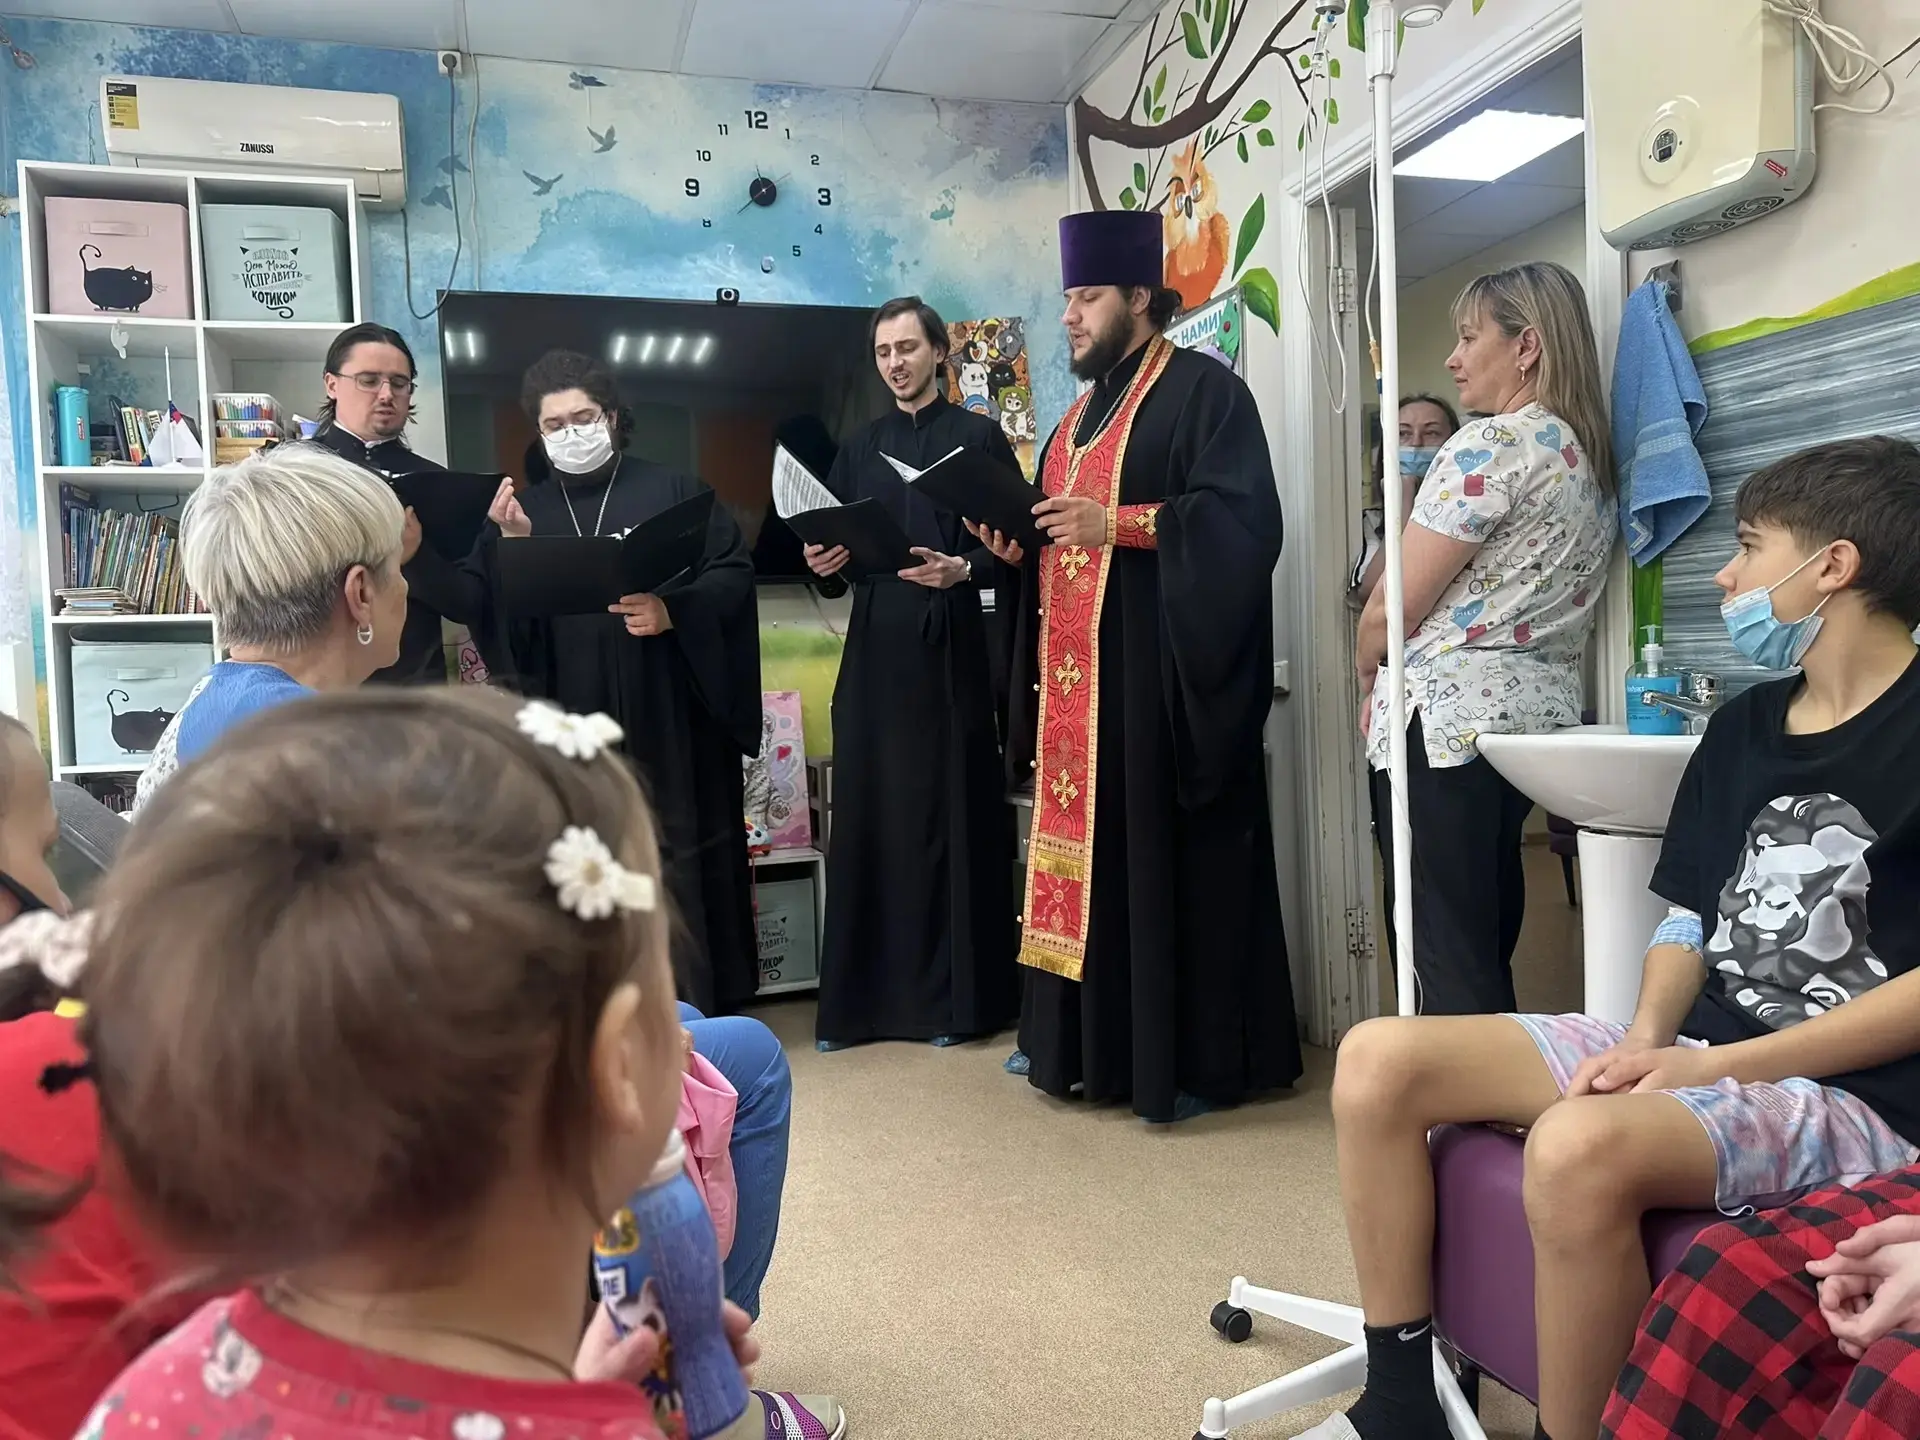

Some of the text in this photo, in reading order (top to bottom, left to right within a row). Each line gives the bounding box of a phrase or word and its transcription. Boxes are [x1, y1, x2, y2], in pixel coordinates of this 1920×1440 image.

[744, 110, 768, 129] 12
[718, 124, 728, 135] 11
[785, 128, 790, 139] 1
[240, 142, 274, 154] ZANUSSI
[696, 150, 711, 161] 10
[810, 154, 820, 165] 2
[685, 178, 700, 197] 9
[818, 188, 831, 206] 3
[814, 224, 823, 235] 4
[727, 244, 735, 255] 7
[792, 245, 801, 257] 5
[241, 270, 303, 289] ИСПРАВИТЬ
[251, 290, 297, 306] КОТИКОМ
[1456, 455, 1484, 464] SMILE
[758, 936, 790, 952] РАВИТЬ
[758, 954, 785, 971] ТИКОМ
